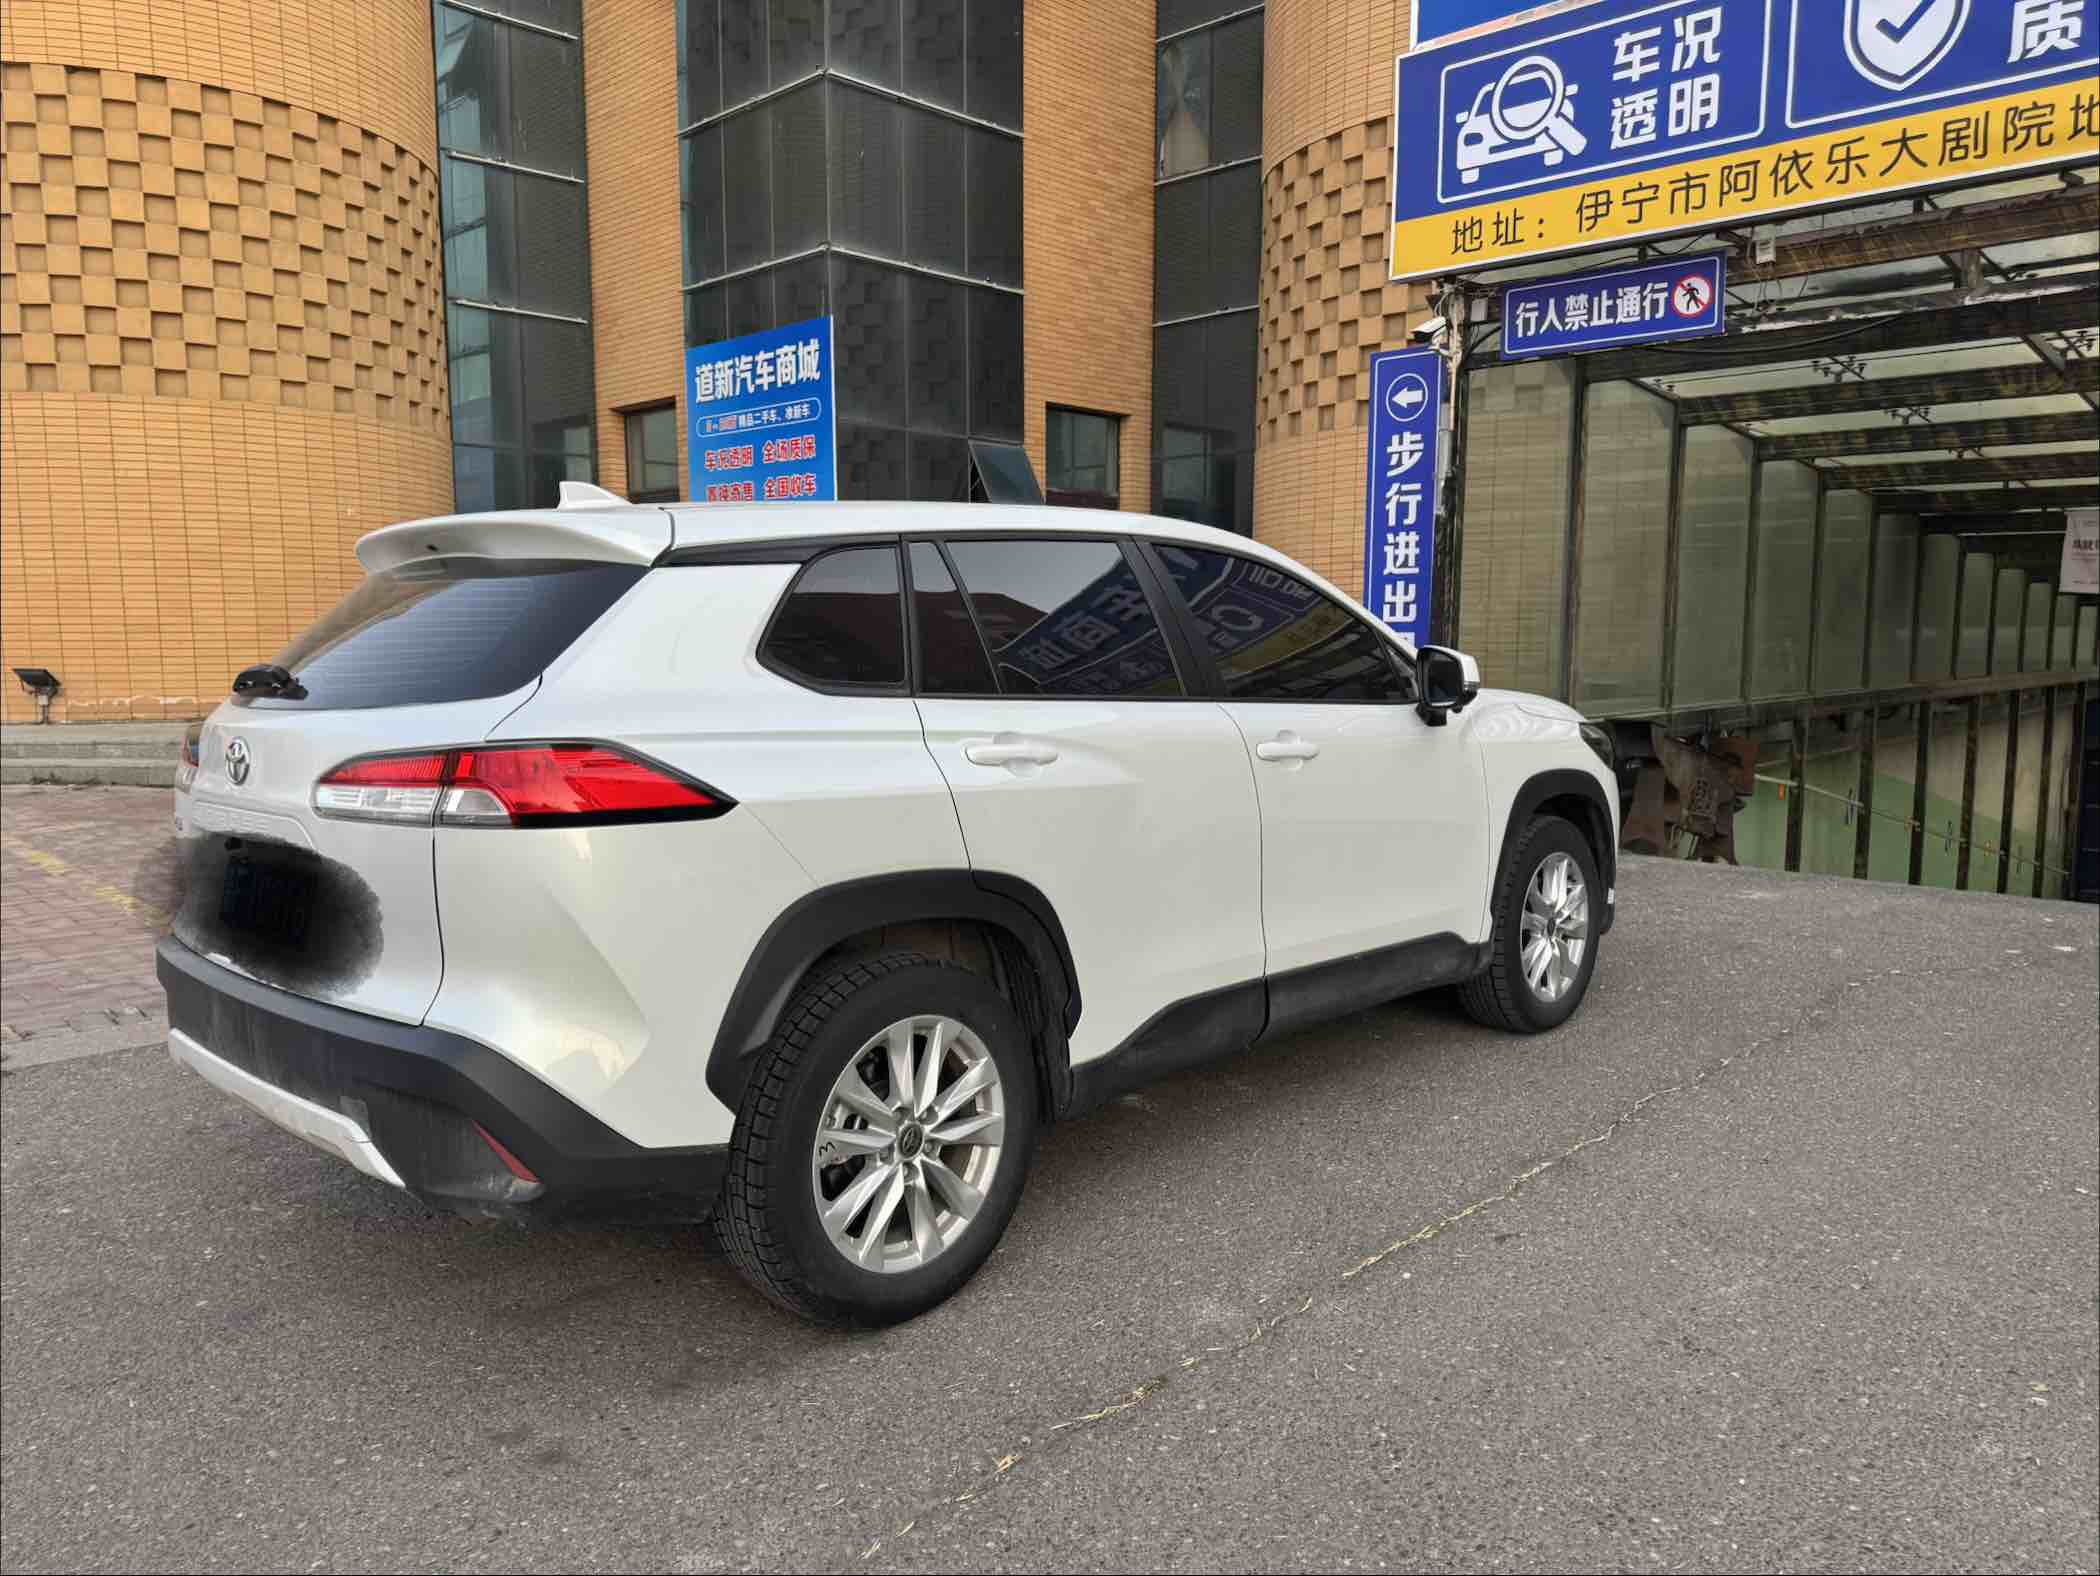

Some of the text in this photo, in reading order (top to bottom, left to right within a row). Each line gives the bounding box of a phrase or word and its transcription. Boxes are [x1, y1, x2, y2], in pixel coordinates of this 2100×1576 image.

[1612, 6, 1722, 82] 车况
[2006, 0, 2085, 63] 质
[1610, 73, 1720, 150] 透明
[1515, 281, 1669, 338] 行人禁止通行
[694, 338, 822, 404] 道新汽车商城
[704, 445, 754, 472] 车况透明
[762, 434, 817, 464] 全场质保
[764, 472, 817, 500] 全国收车
